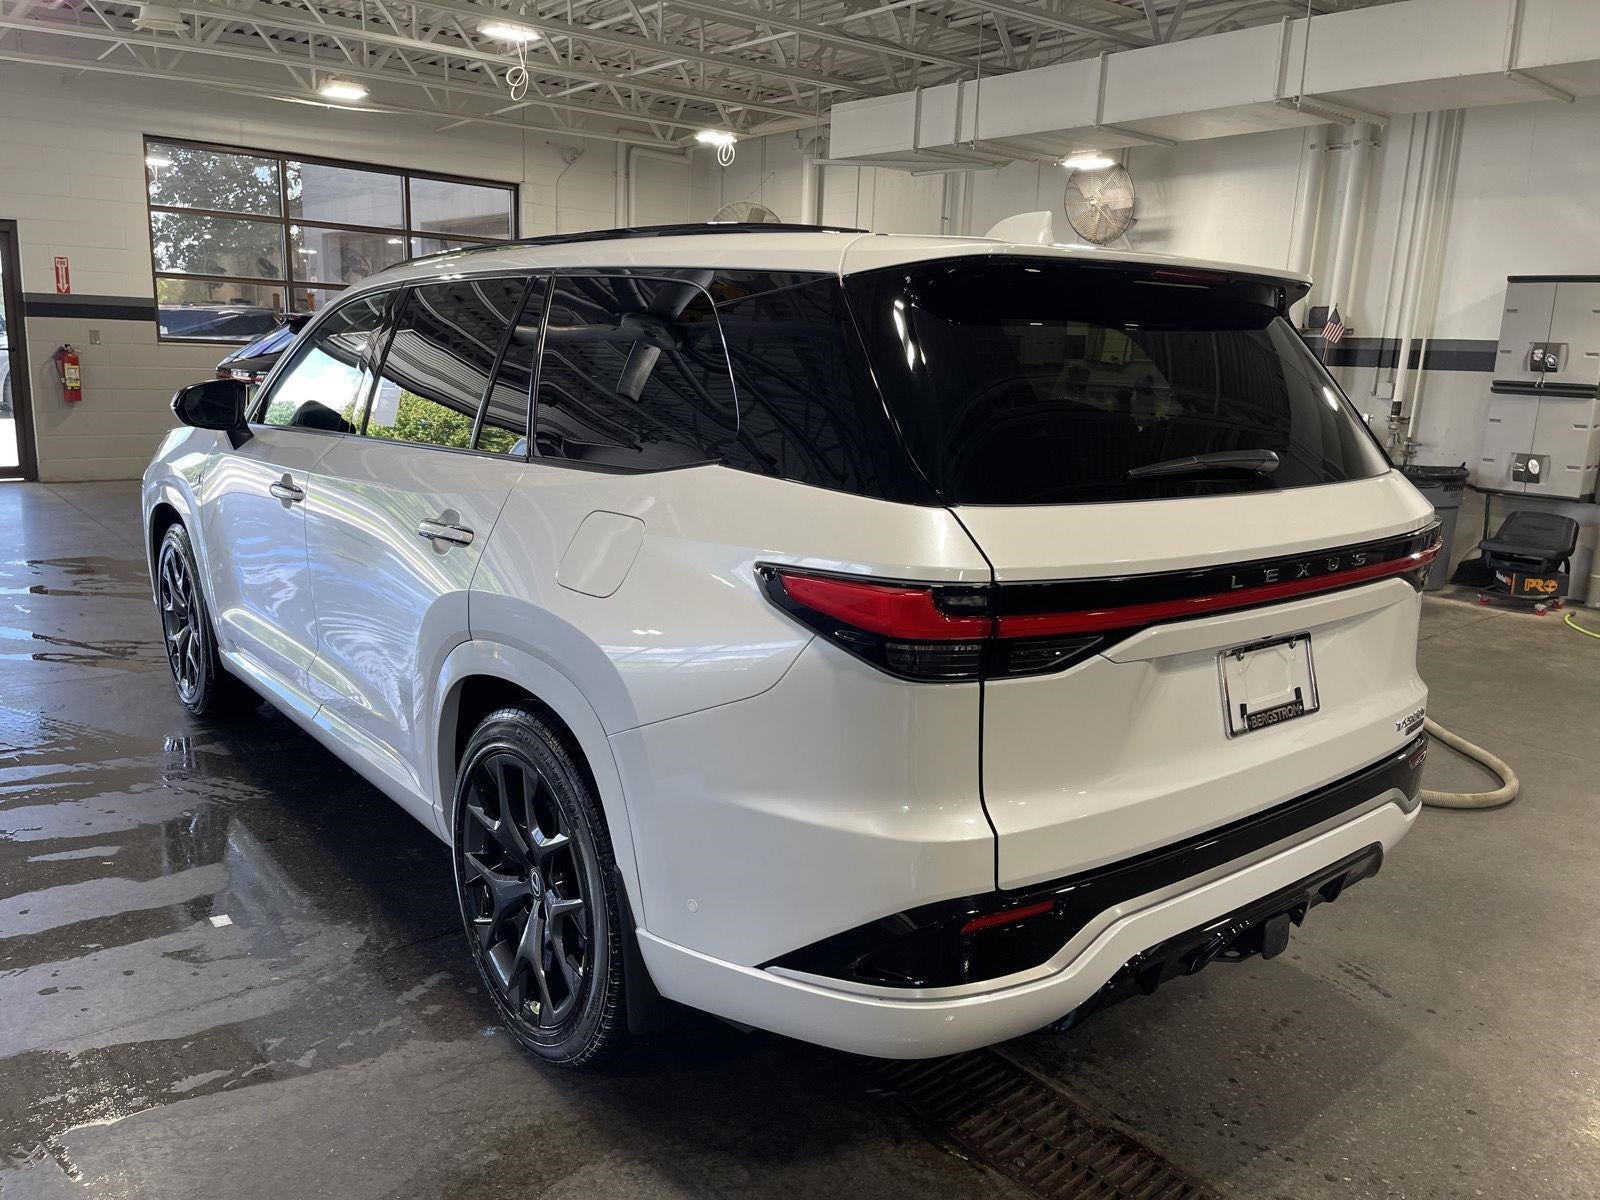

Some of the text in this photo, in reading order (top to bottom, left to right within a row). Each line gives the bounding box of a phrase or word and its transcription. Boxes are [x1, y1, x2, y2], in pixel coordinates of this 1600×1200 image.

[1231, 552, 1367, 589] LEXUS
[1523, 577, 1558, 593] PRO
[1250, 703, 1301, 728] BERGSTROM
